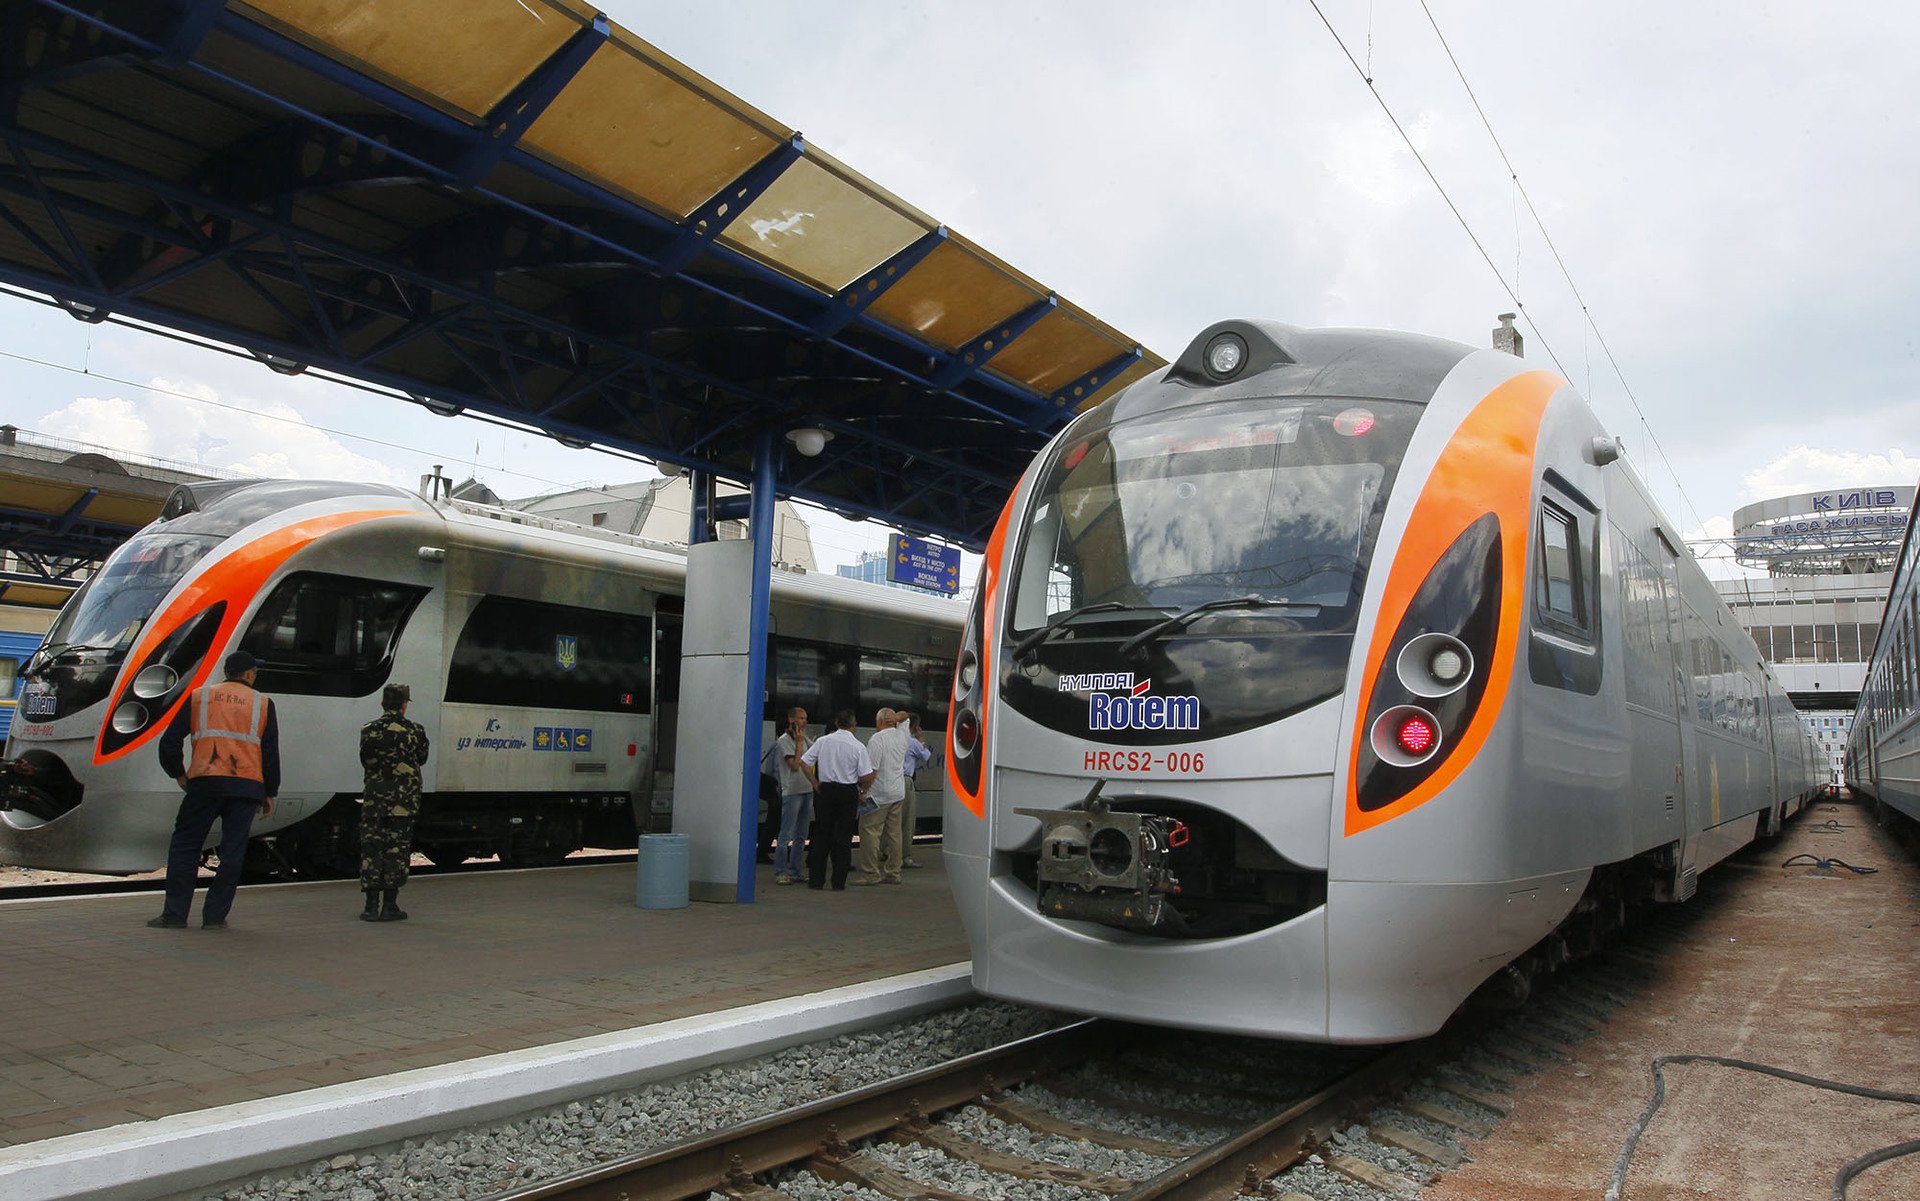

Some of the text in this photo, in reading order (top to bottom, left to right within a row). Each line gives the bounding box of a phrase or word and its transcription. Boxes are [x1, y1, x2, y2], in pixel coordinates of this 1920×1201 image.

[1812, 488, 1897, 511] КИЇВ
[1058, 672, 1135, 692] HYUNDAI
[1089, 692, 1200, 730] Rotem
[1084, 751, 1205, 773] HRCS2-006
